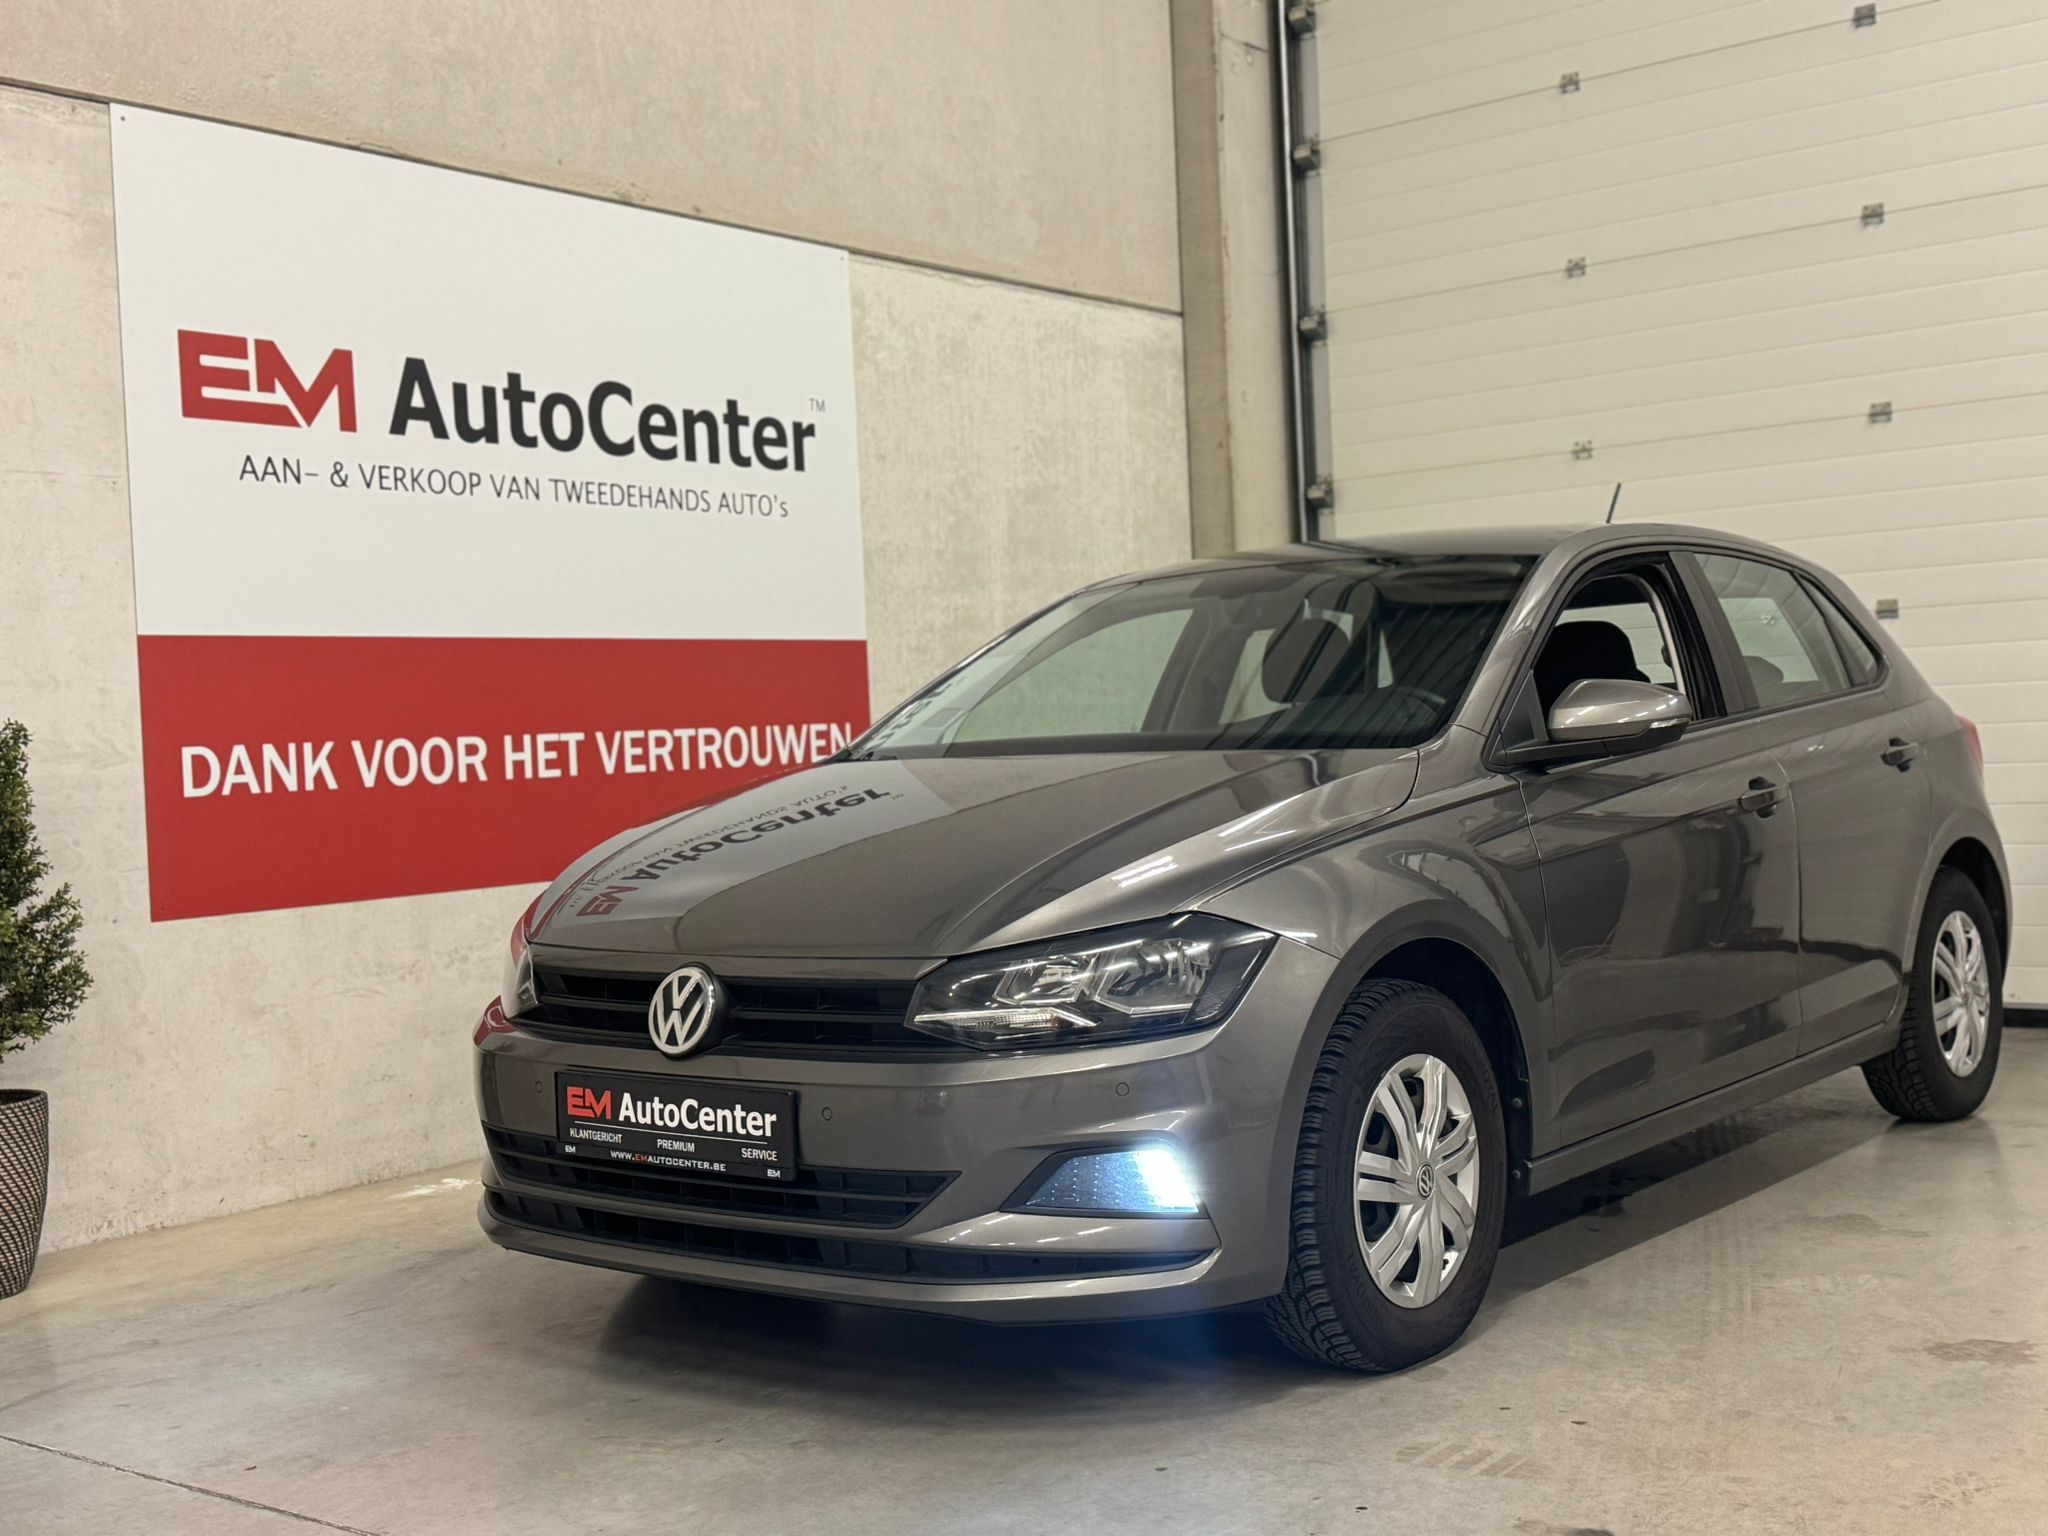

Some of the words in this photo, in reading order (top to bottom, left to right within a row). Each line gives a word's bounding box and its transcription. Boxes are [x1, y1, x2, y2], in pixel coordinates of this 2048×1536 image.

[177, 329, 357, 433] EM
[389, 357, 816, 472] AutoCenter
[330, 461, 349, 488] &
[358, 463, 482, 497] VERKOOP
[490, 474, 540, 501] VAN
[548, 478, 711, 513] TWEEDEHANDS
[181, 741, 339, 798] DANK
[351, 736, 488, 788] VOOR
[504, 732, 585, 780] HET
[595, 722, 852, 775] VERTROUWEN
[566, 1086, 612, 1121] EM
[618, 1092, 777, 1138] AutoCenter
[569, 1127, 623, 1144] KLANTGERICHT
[657, 1138, 695, 1153] PREMIUM
[741, 1147, 778, 1161] SERVICE
[610, 1150, 727, 1172] WWW.EMAUTOCENTER.BE
